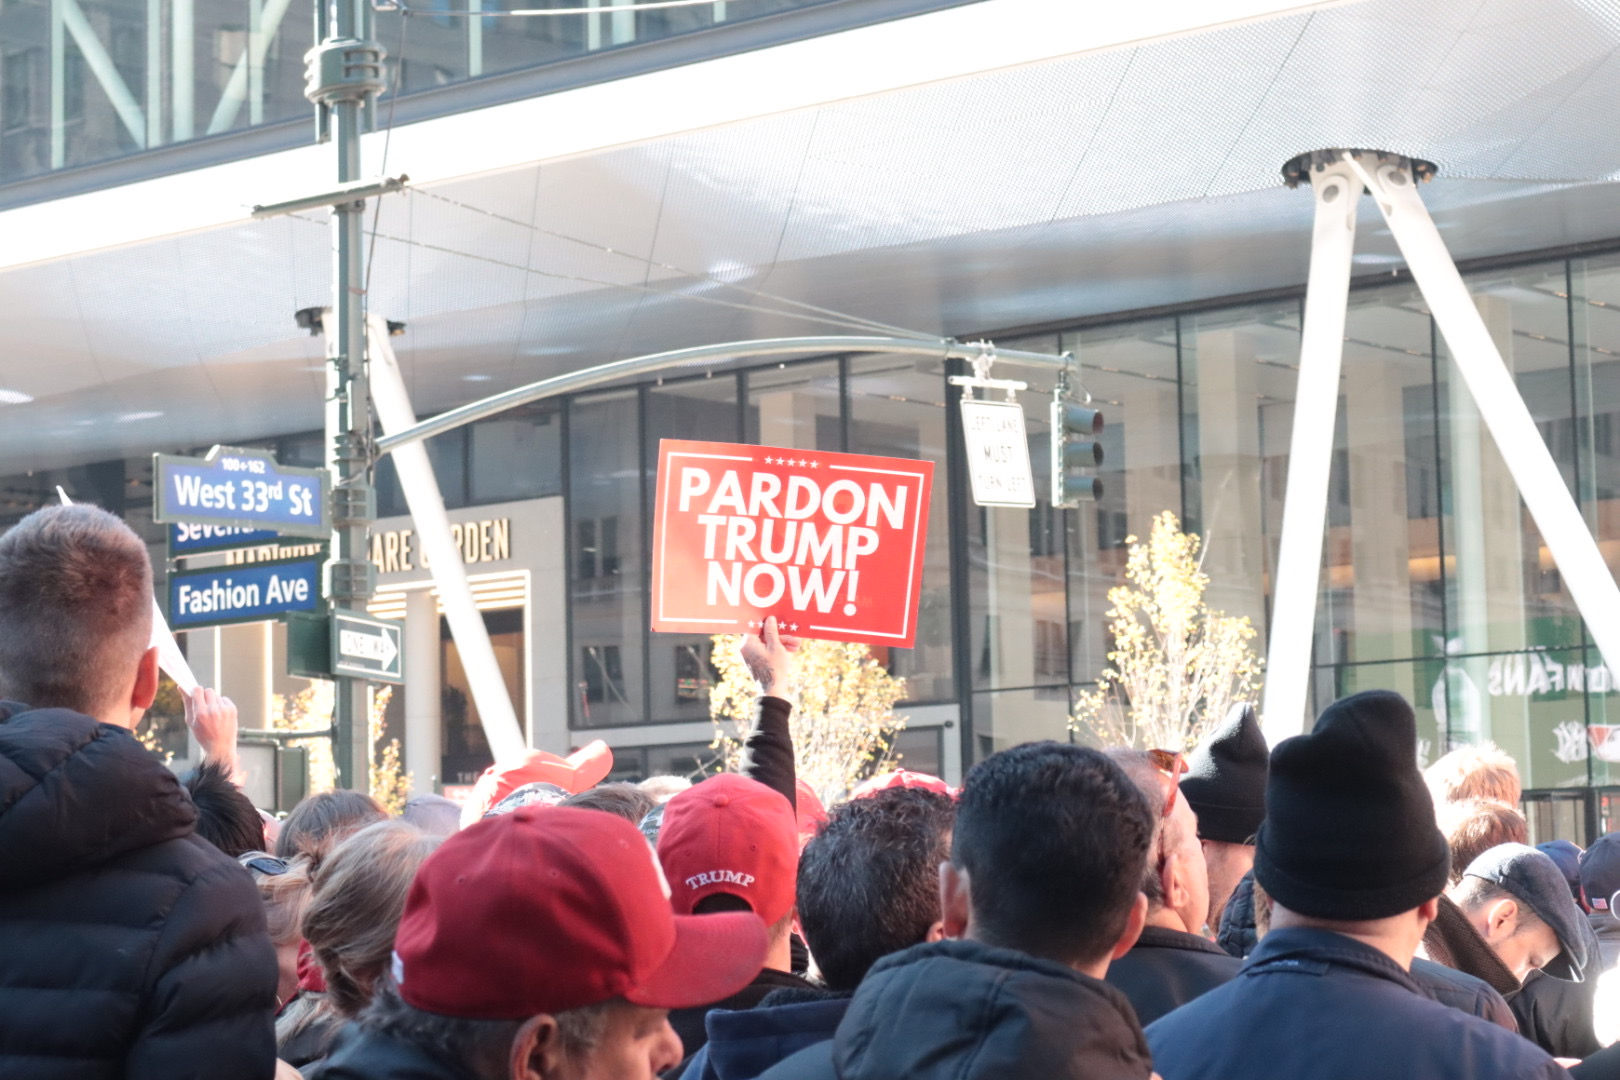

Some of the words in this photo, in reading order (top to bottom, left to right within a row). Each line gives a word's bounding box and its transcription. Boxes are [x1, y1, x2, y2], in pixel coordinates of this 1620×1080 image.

[983, 445, 1013, 463] MUST
[173, 474, 236, 510] West
[241, 480, 283, 512] 33rd
[288, 484, 313, 516] St
[678, 466, 908, 530] PARDON
[697, 513, 880, 571] TRUMP
[178, 578, 260, 615] Fashion
[265, 574, 309, 605] Ave
[706, 560, 860, 617] NOW!
[685, 870, 756, 890] TRUMP
